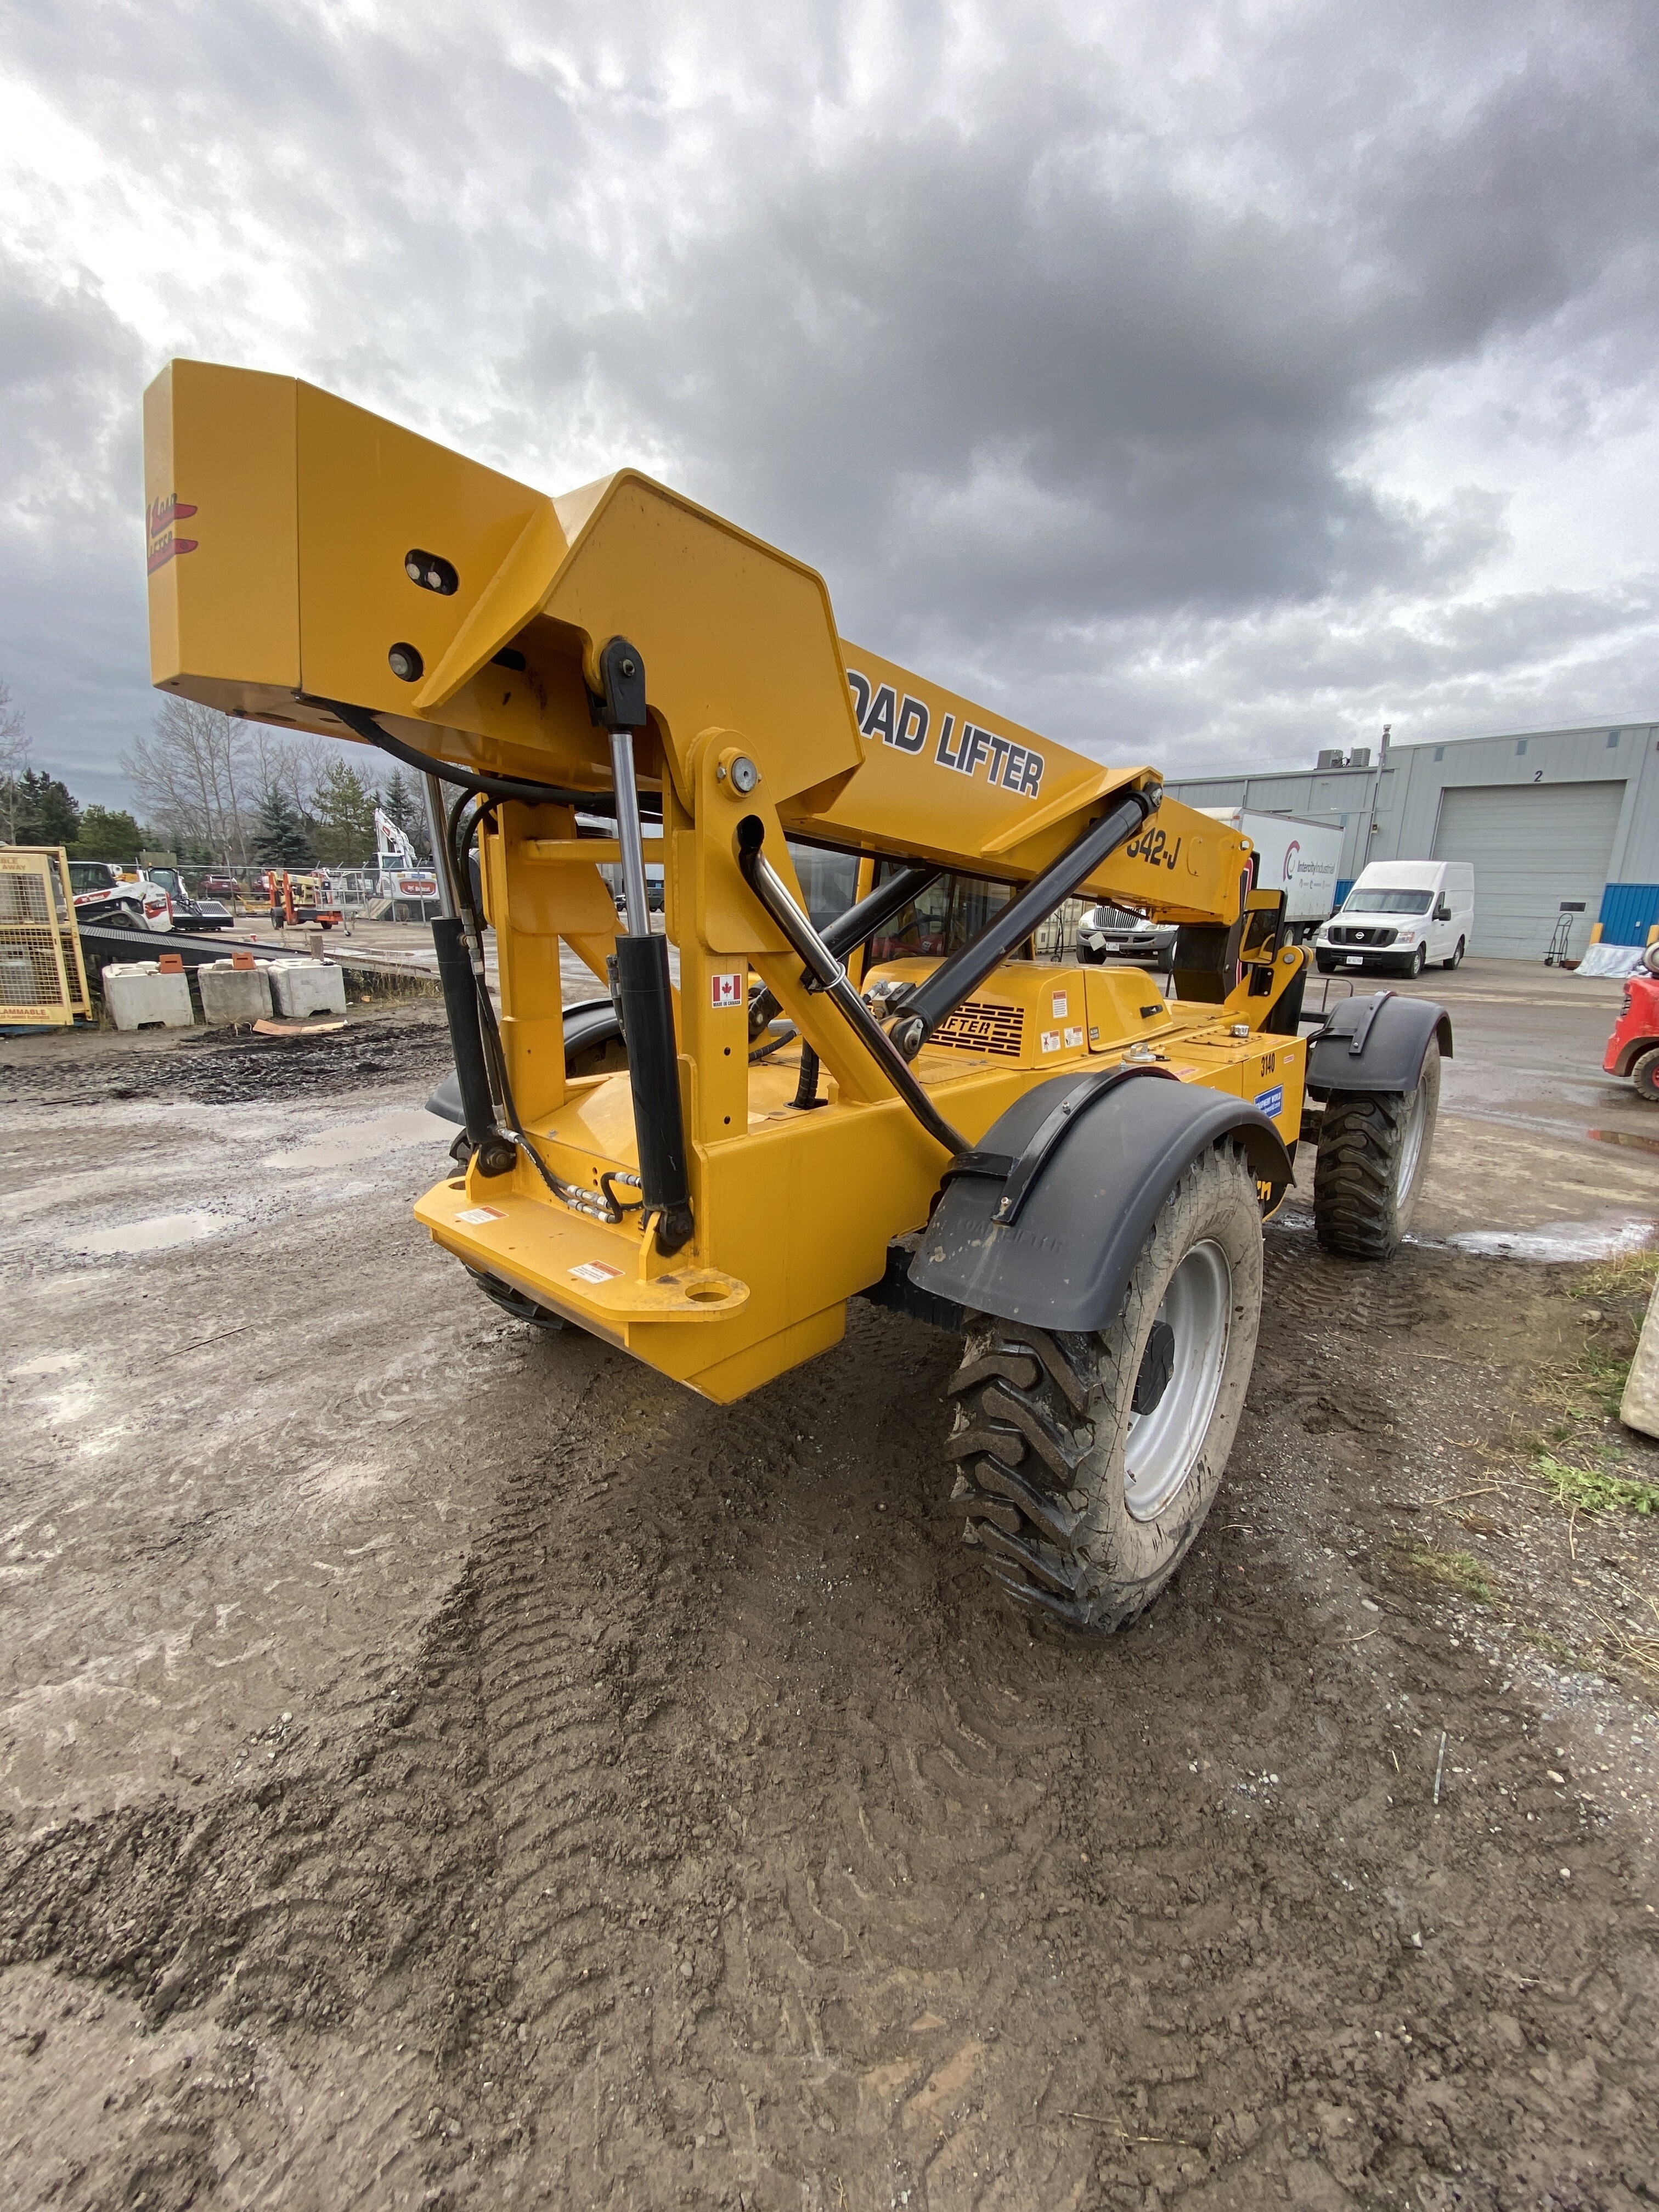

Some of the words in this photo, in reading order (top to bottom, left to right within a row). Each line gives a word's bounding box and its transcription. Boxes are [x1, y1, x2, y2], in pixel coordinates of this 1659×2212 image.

[934, 712, 1045, 800] LIFTER
[1534, 770, 1543, 782] 2
[1261, 1052, 1276, 1077] 3140
